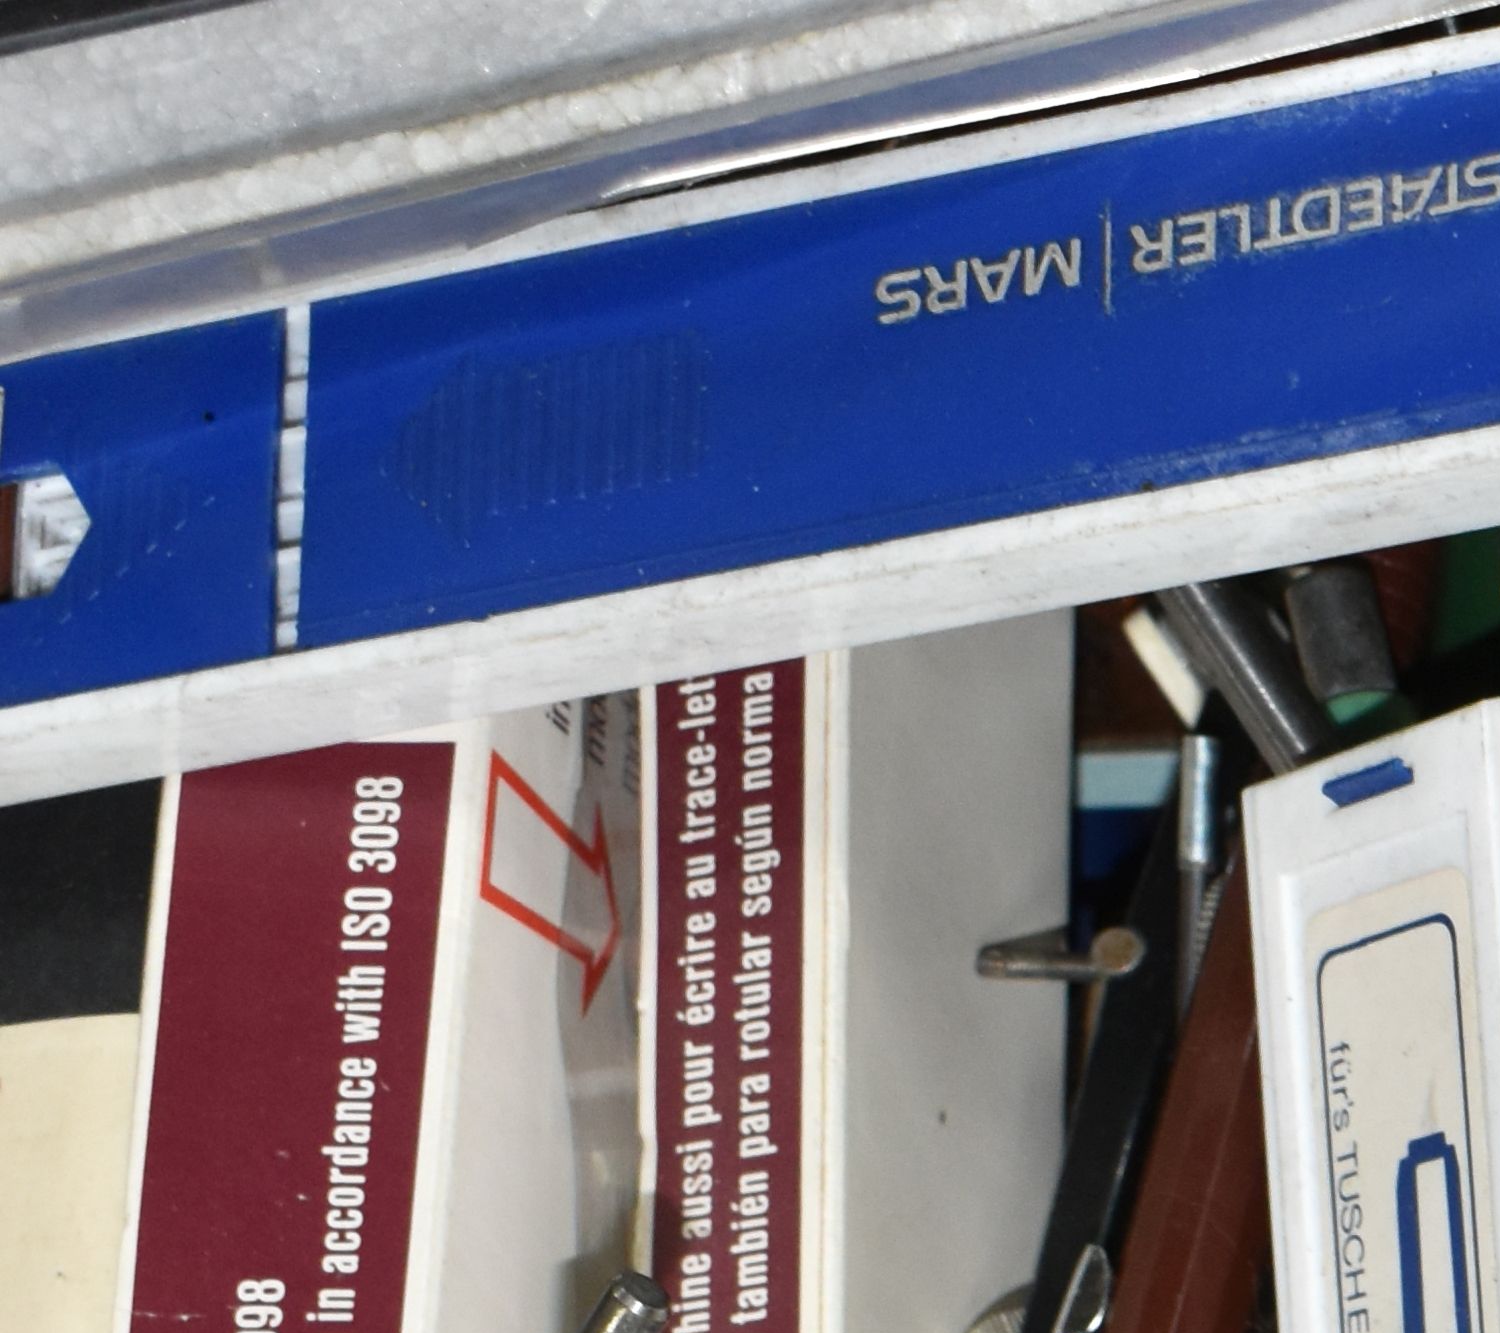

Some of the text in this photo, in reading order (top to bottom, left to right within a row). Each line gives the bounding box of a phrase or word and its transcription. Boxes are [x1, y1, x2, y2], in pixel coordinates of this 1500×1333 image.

[874, 233, 1082, 326] MARS
[672, 674, 716, 843] trace-let
[742, 671, 773, 791] norma
[346, 775, 404, 873] 3098
[733, 803, 780, 917] según
[339, 886, 393, 951] ISO
[685, 853, 716, 899] au
[334, 964, 386, 1044] with
[675, 910, 716, 1026] écrire
[732, 930, 772, 1061] rotular
[682, 1040, 720, 1128] pour
[738, 1073, 778, 1159] para
[320, 1056, 377, 1274] accordance
[674, 1138, 713, 1239] aussi
[728, 1170, 769, 1325] también
[305, 1287, 356, 1322] in
